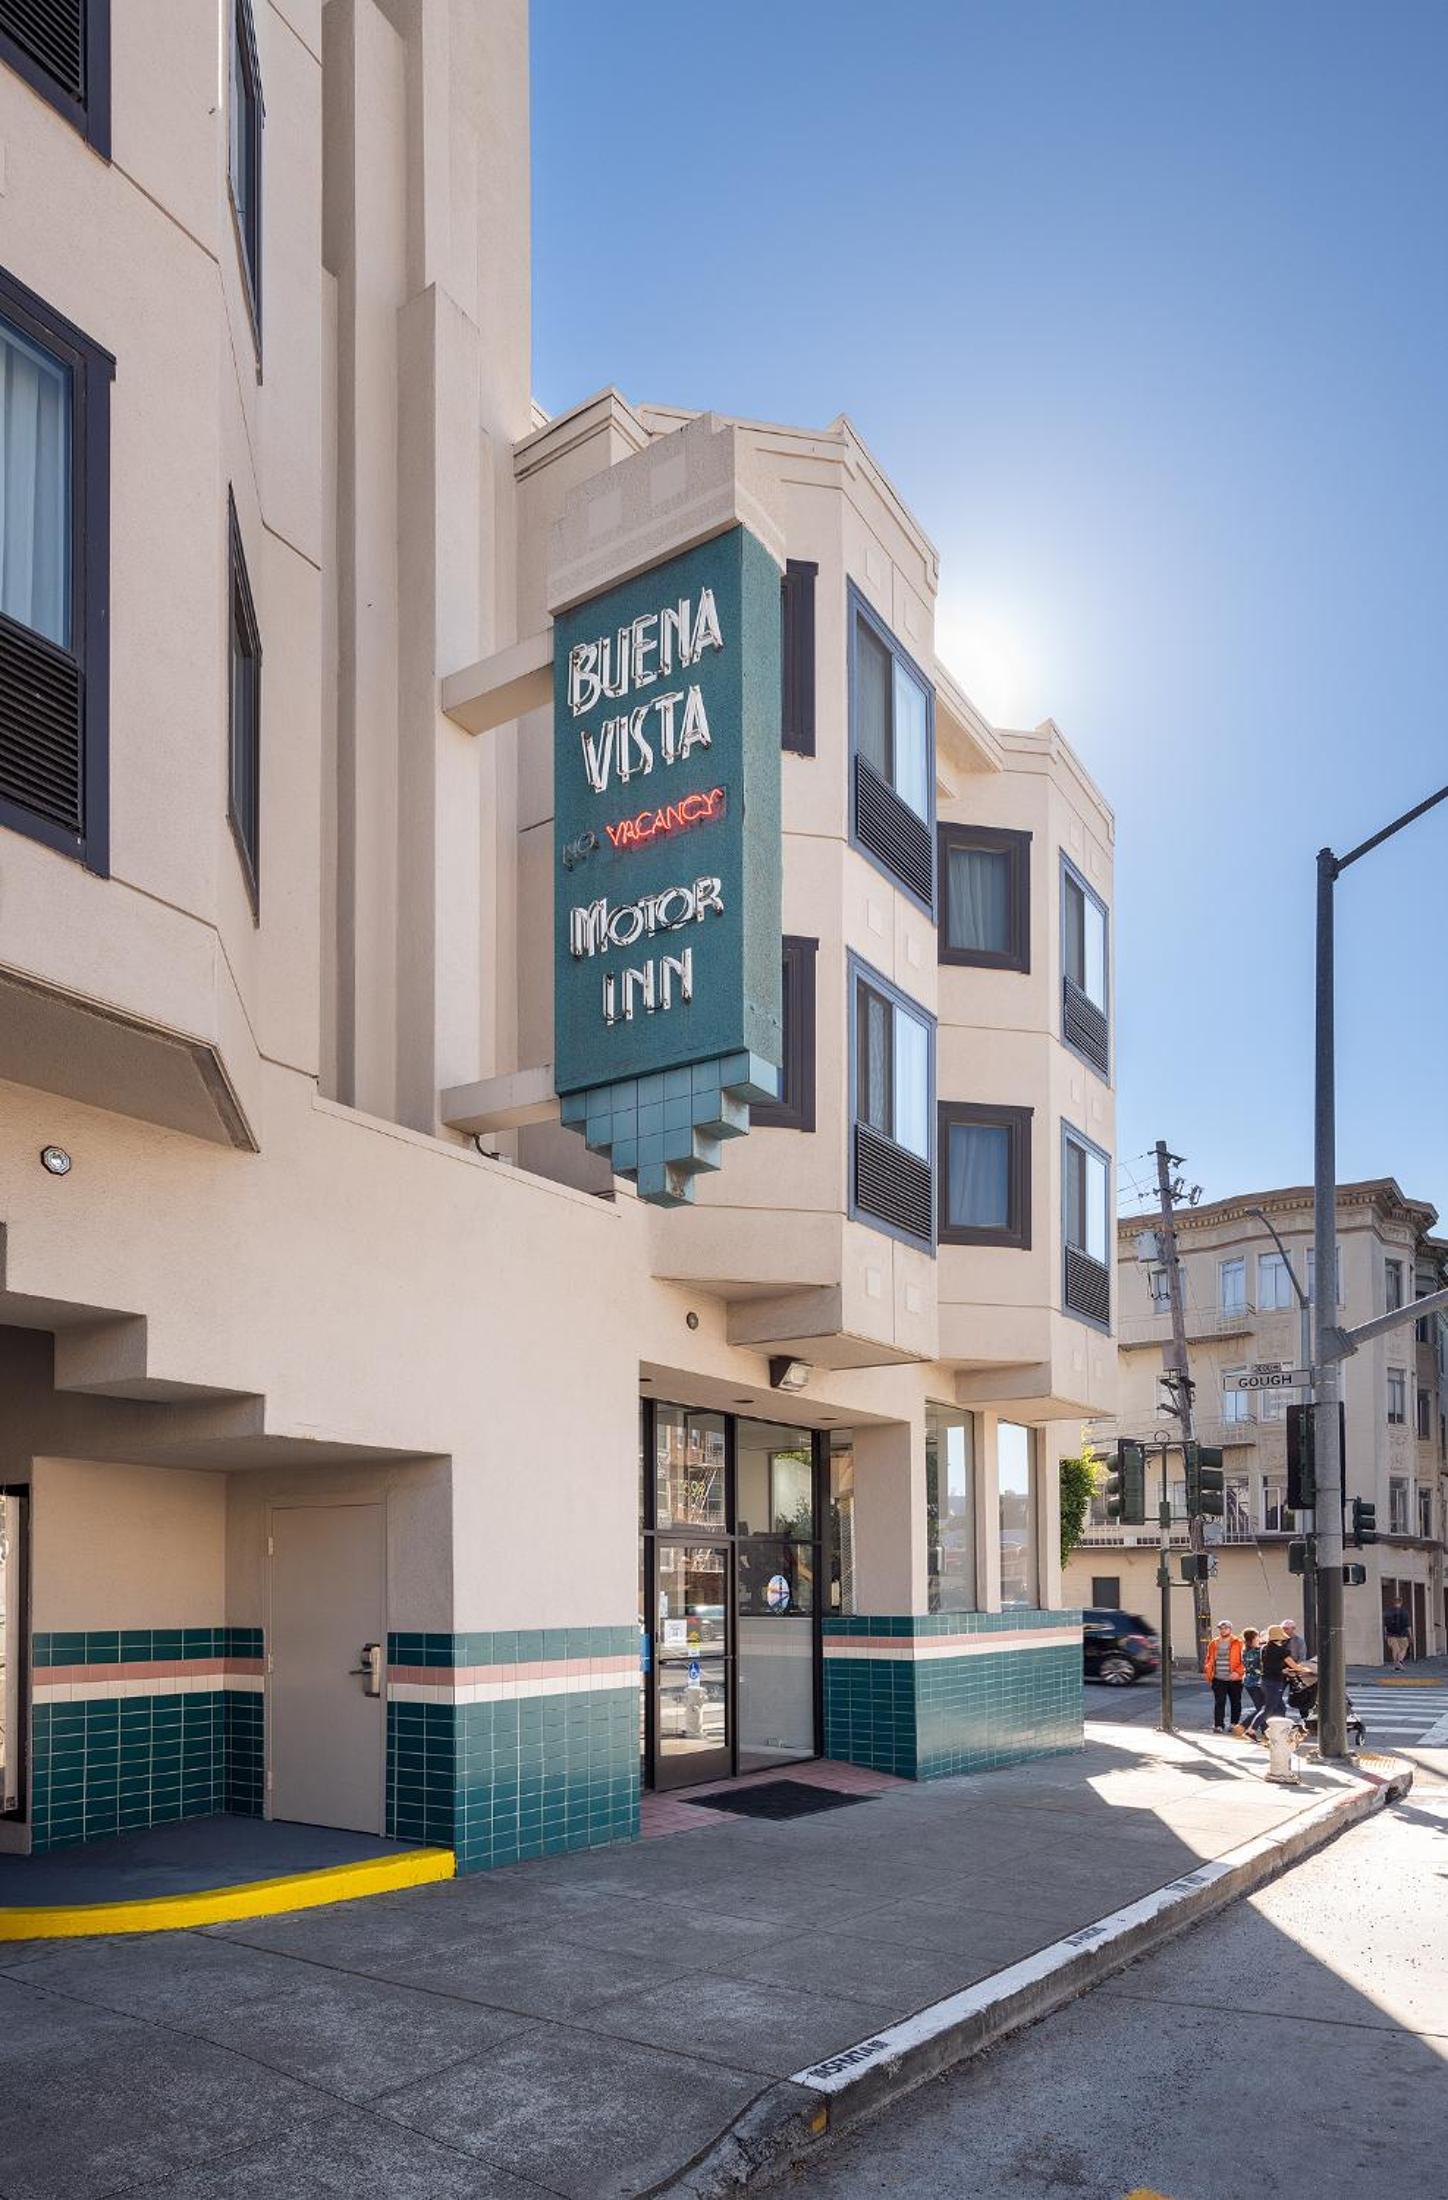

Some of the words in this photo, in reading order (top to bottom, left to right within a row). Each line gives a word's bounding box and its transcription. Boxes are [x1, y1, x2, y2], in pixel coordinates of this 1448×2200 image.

[568, 587, 724, 716] BUENA
[581, 684, 713, 793] VISTA
[605, 788, 723, 847] VACANCY
[570, 877, 724, 959] MOTOR
[603, 947, 693, 1026] INN
[1239, 1374, 1292, 1388] GOUGH
